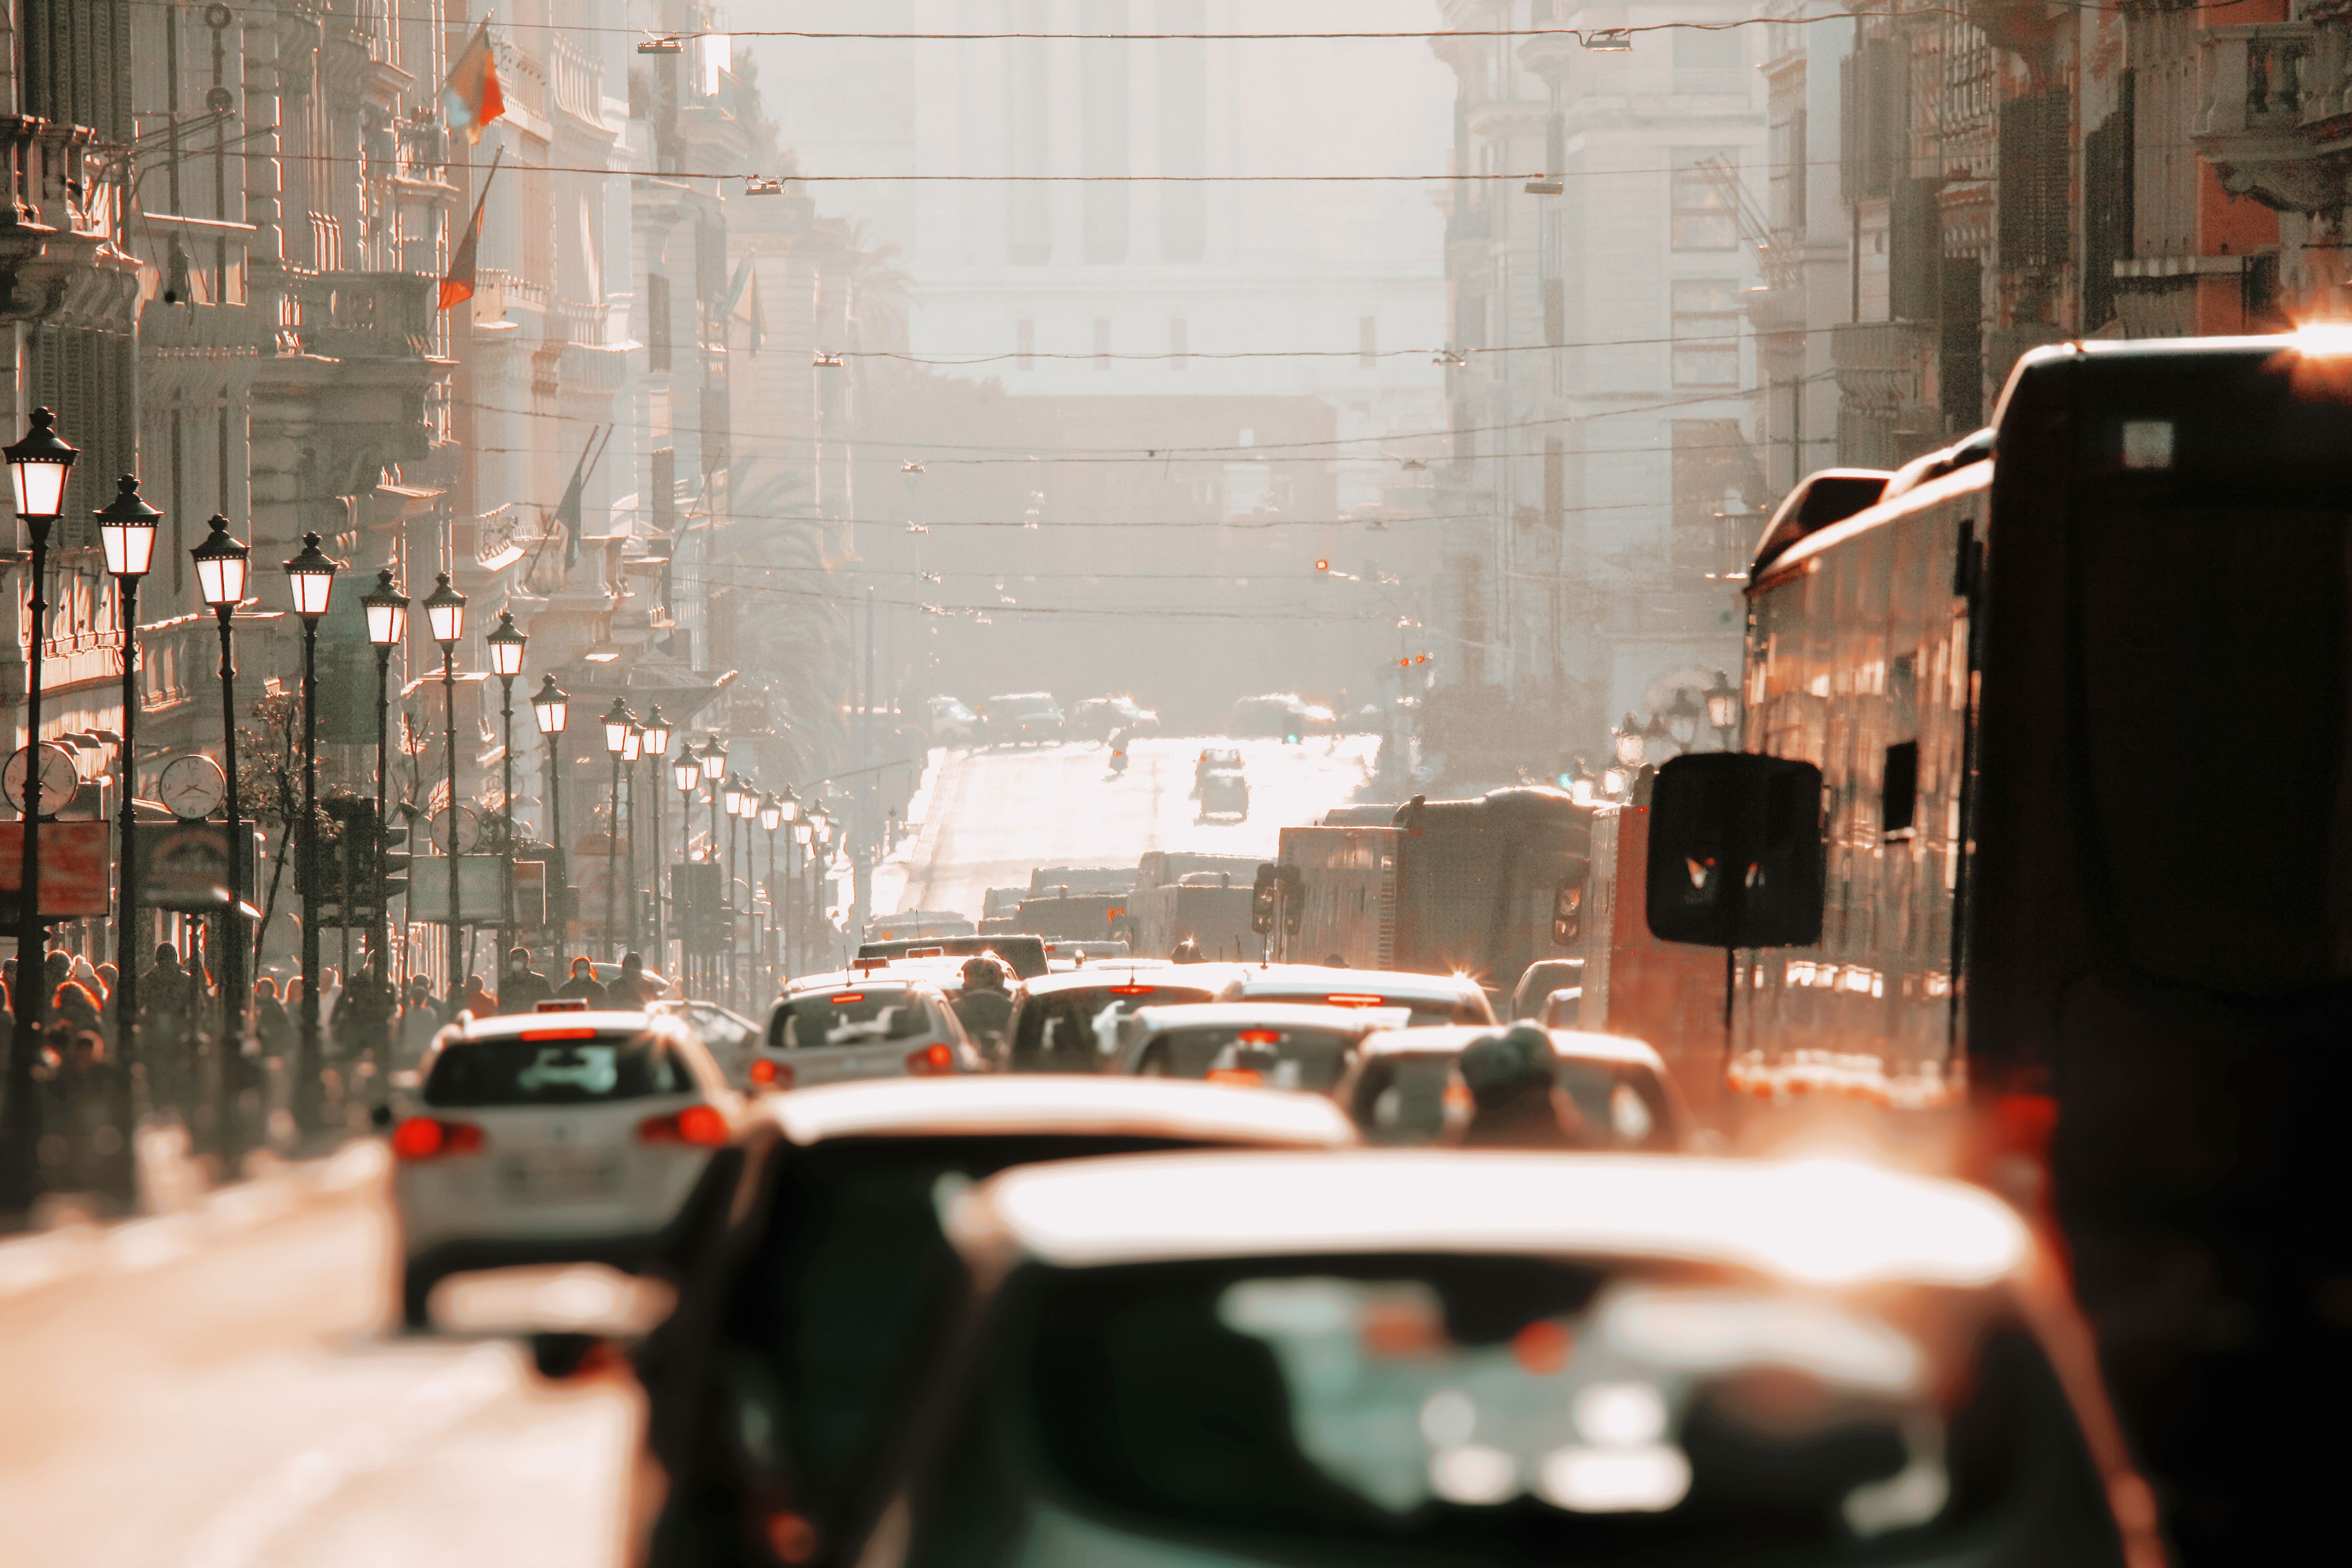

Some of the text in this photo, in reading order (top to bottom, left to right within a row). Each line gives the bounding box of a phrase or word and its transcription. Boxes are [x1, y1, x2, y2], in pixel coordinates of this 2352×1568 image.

[187, 760, 199, 770] 12
[164, 783, 171, 792] 9
[188, 804, 196, 815] 6
